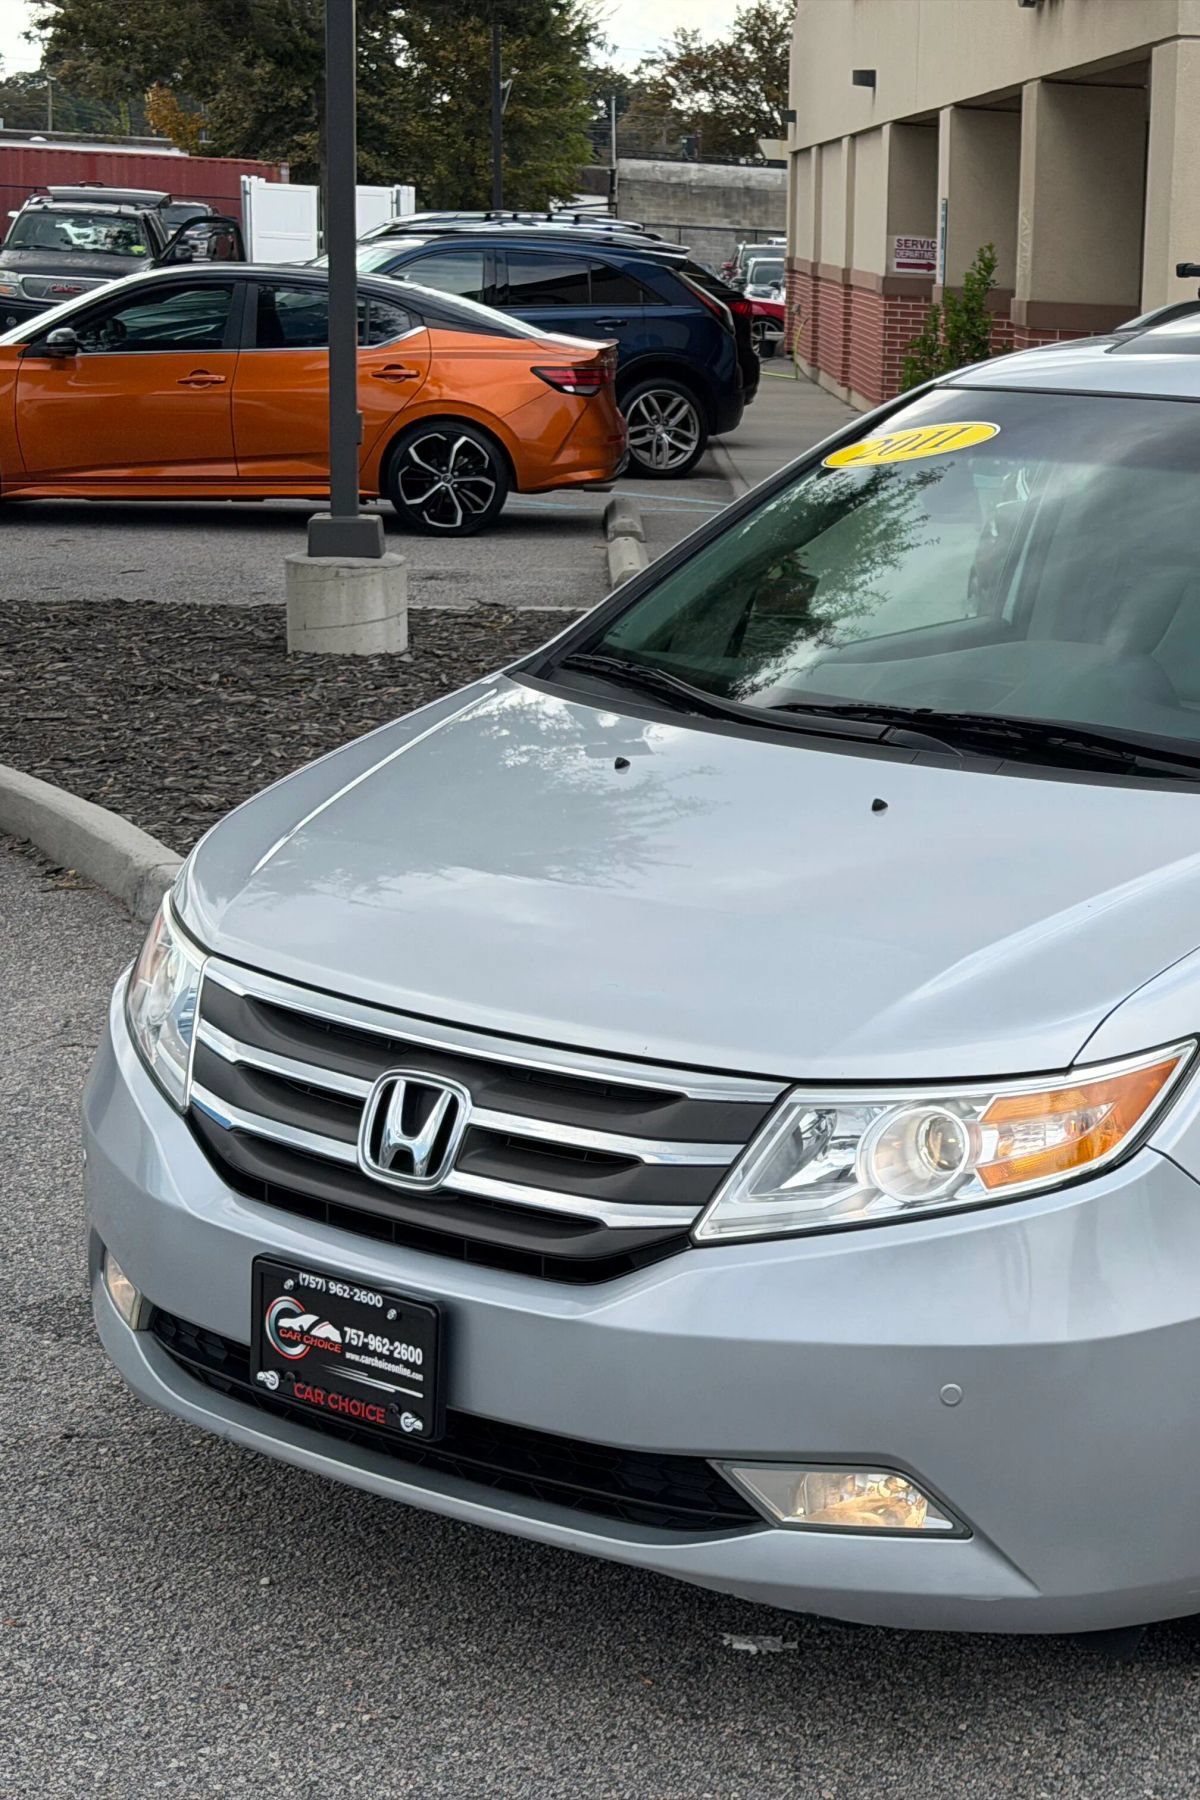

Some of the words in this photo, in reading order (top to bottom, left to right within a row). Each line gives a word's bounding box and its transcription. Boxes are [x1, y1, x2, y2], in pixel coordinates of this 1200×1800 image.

[896, 238, 937, 250] SERVIC
[896, 250, 937, 260] DEPARTME
[845, 426, 973, 463] 2011
[299, 1271, 326, 1292] (757)
[328, 1282, 384, 1308] 962-2600
[279, 1329, 302, 1342] CAR
[303, 1336, 344, 1354] CHOICE
[343, 1326, 424, 1366] 757-962-2600
[345, 1351, 424, 1381] www.carchoiceonline.com
[293, 1382, 325, 1405] CAR
[327, 1393, 386, 1424] CHOICE
